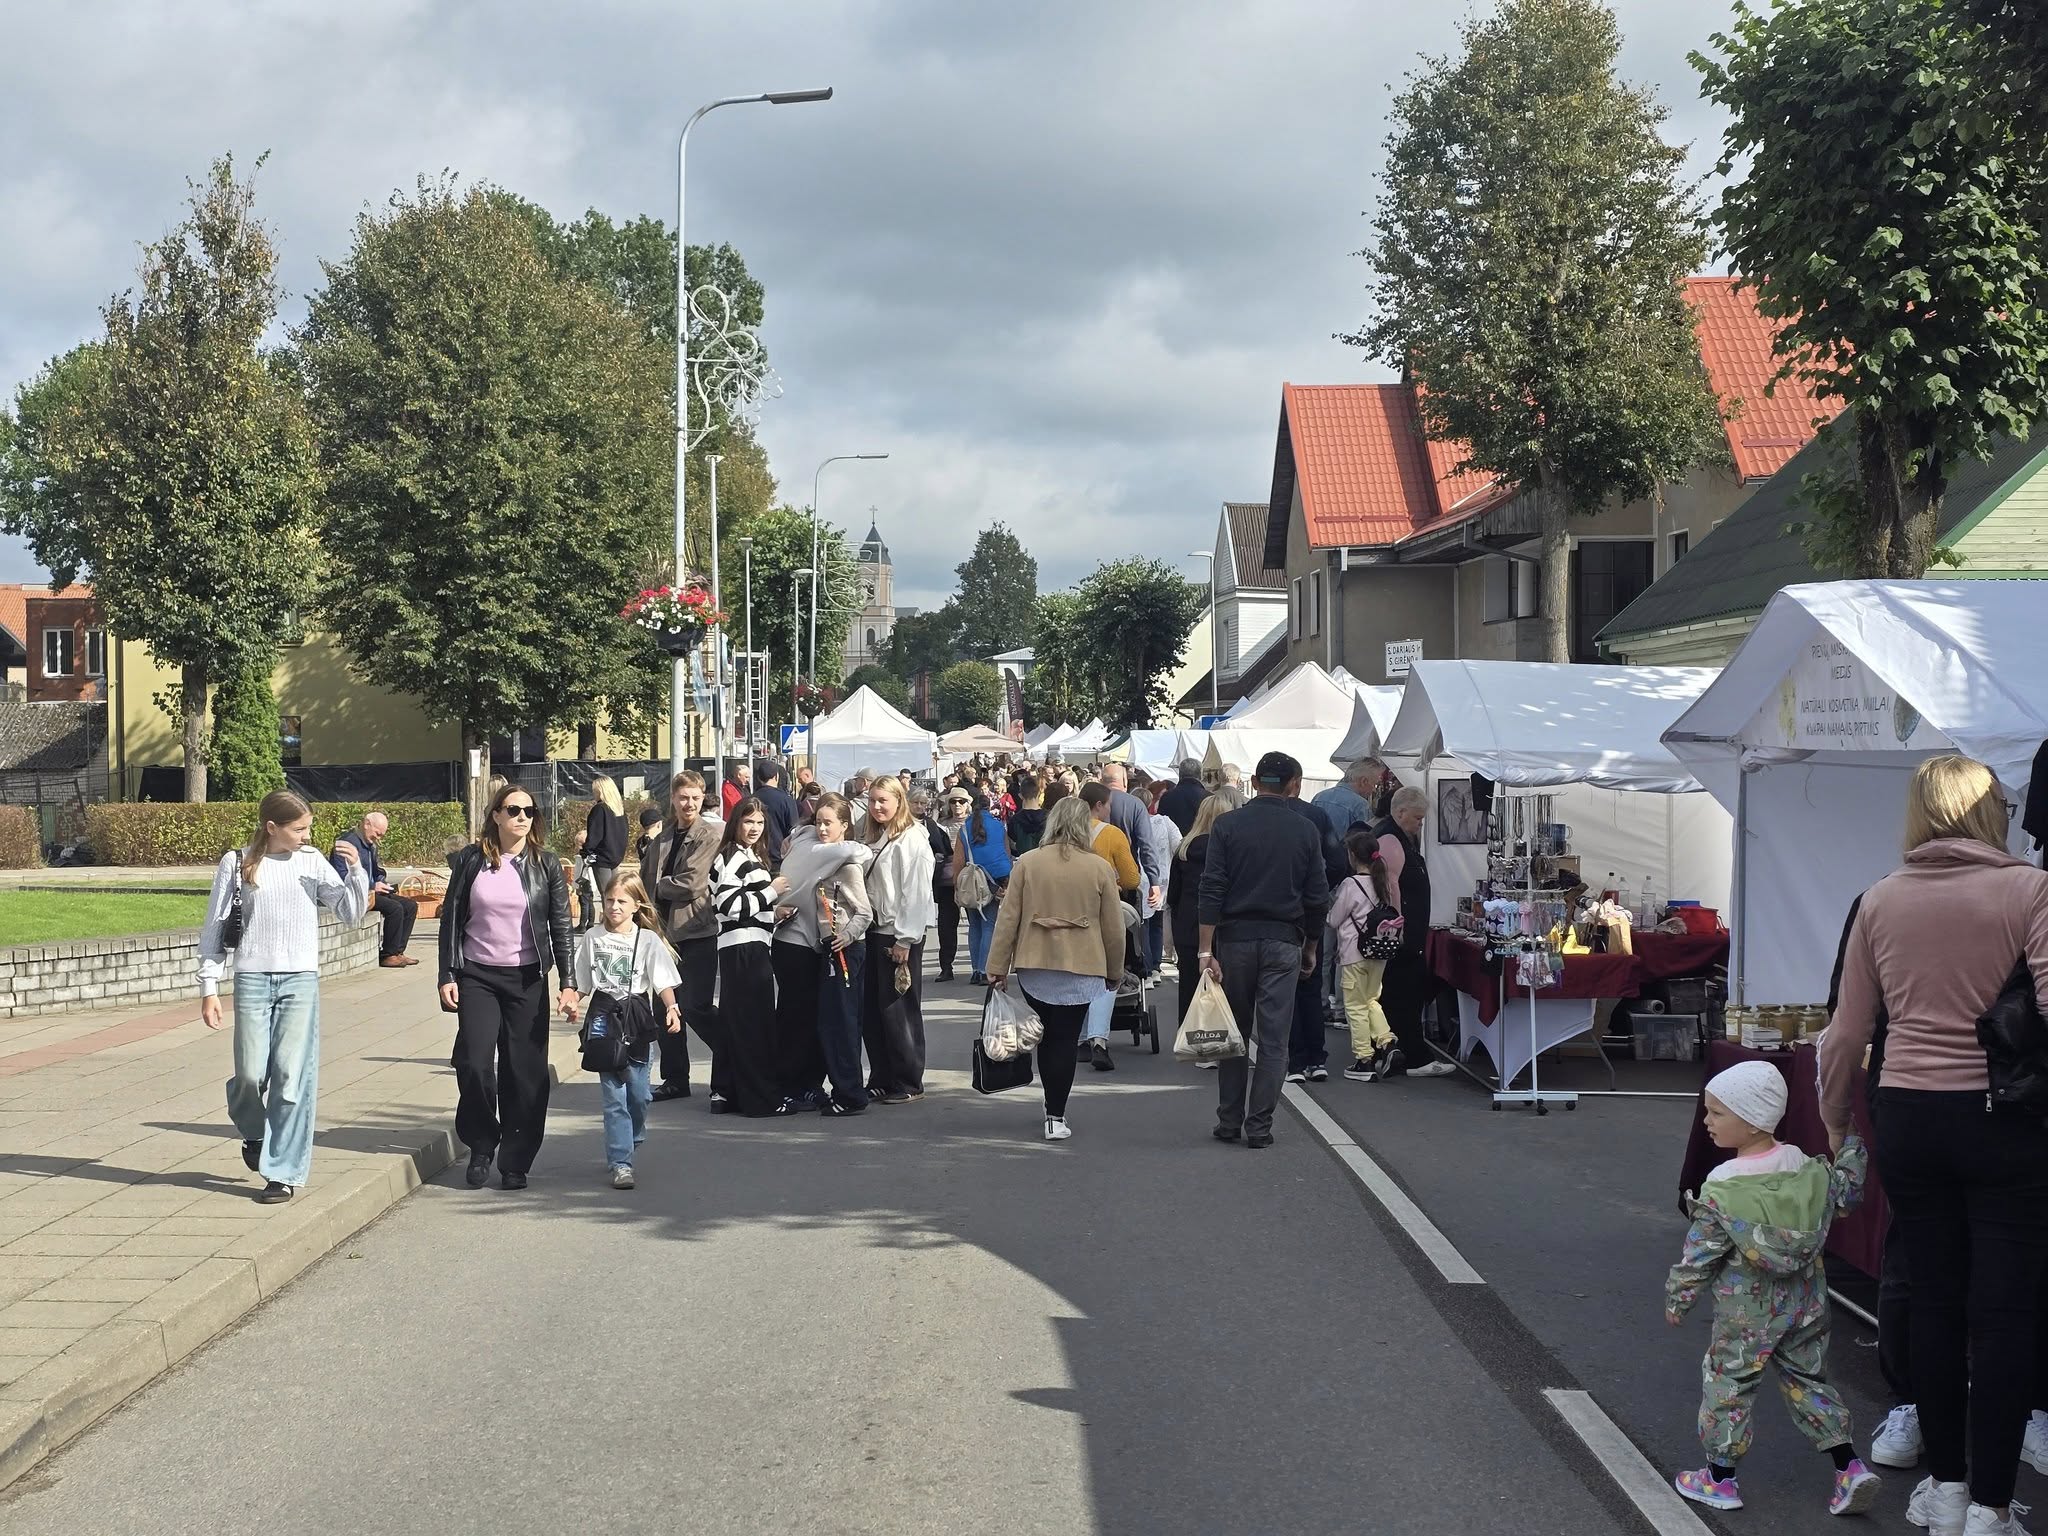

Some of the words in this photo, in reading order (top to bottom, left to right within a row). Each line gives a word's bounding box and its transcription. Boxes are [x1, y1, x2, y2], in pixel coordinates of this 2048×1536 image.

[1393, 644, 1415, 655] DARIAUS
[1831, 665, 1852, 680] MEDUS
[594, 952, 632, 986] 74
